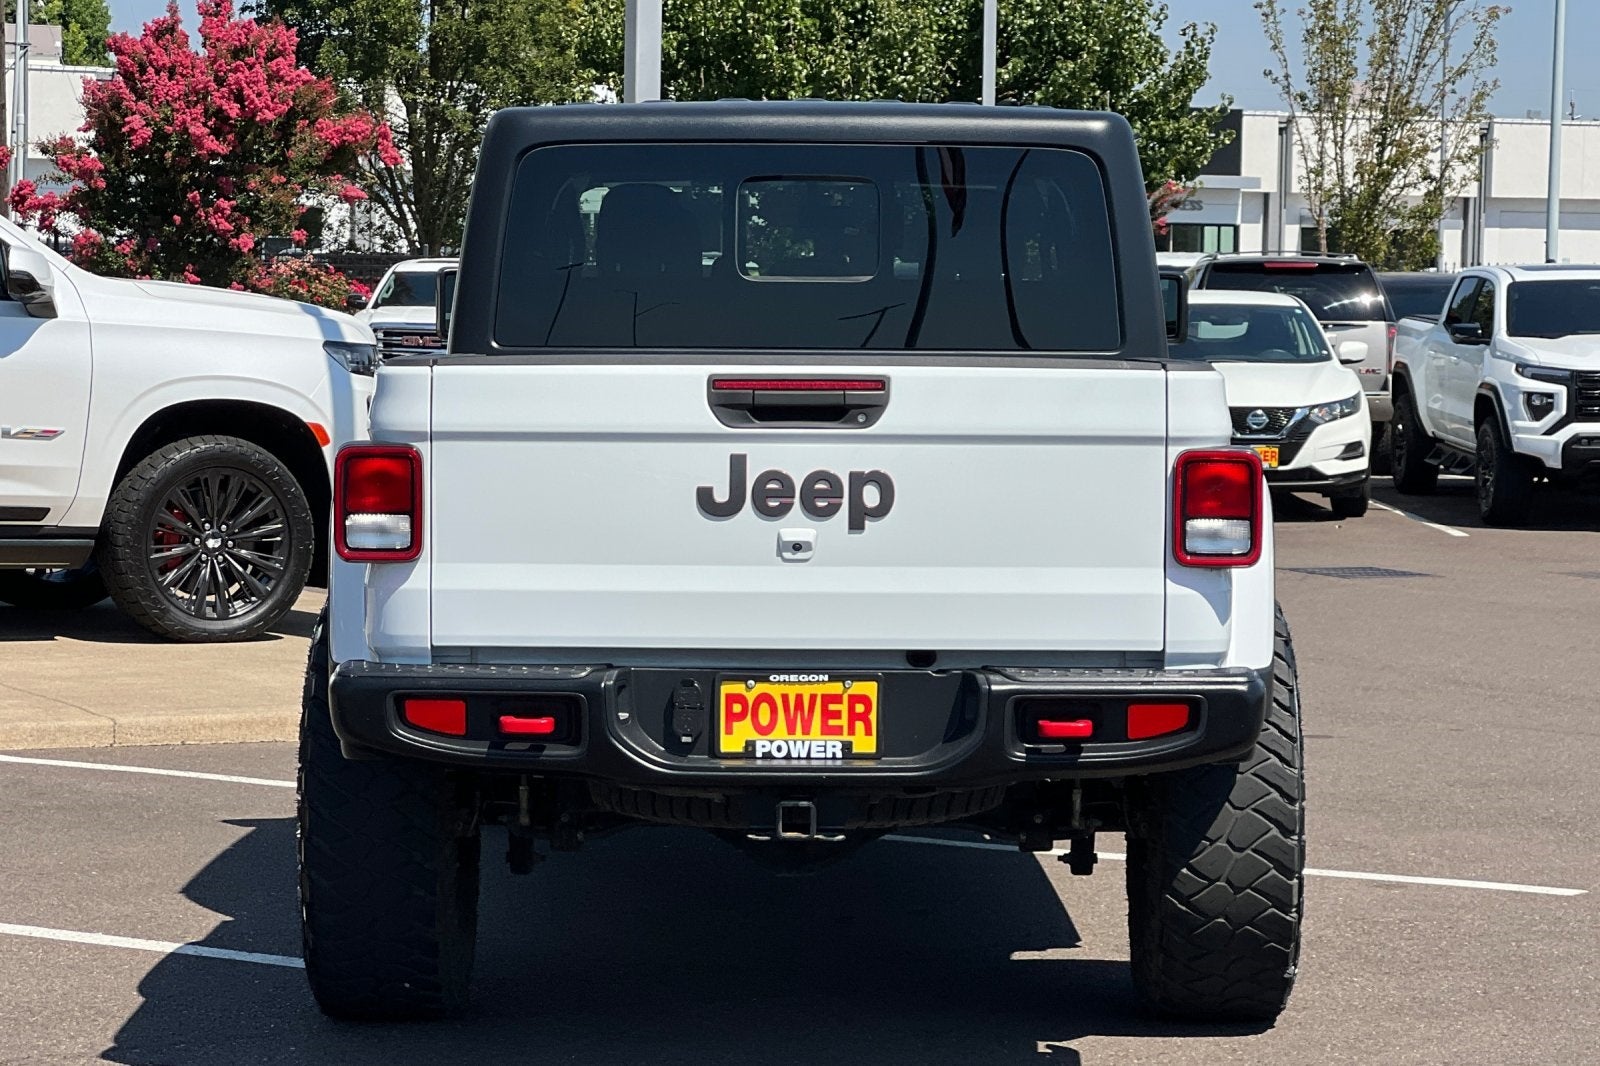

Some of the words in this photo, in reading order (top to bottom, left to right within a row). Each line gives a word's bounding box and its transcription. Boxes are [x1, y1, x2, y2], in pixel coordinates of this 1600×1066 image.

[1180, 199, 1204, 211] ESS
[401, 336, 442, 346] GMC
[1260, 450, 1278, 462] ER
[696, 453, 895, 532] Jeep
[769, 674, 829, 682] OREGON
[724, 692, 873, 737] POWER
[755, 740, 843, 758] POWER
